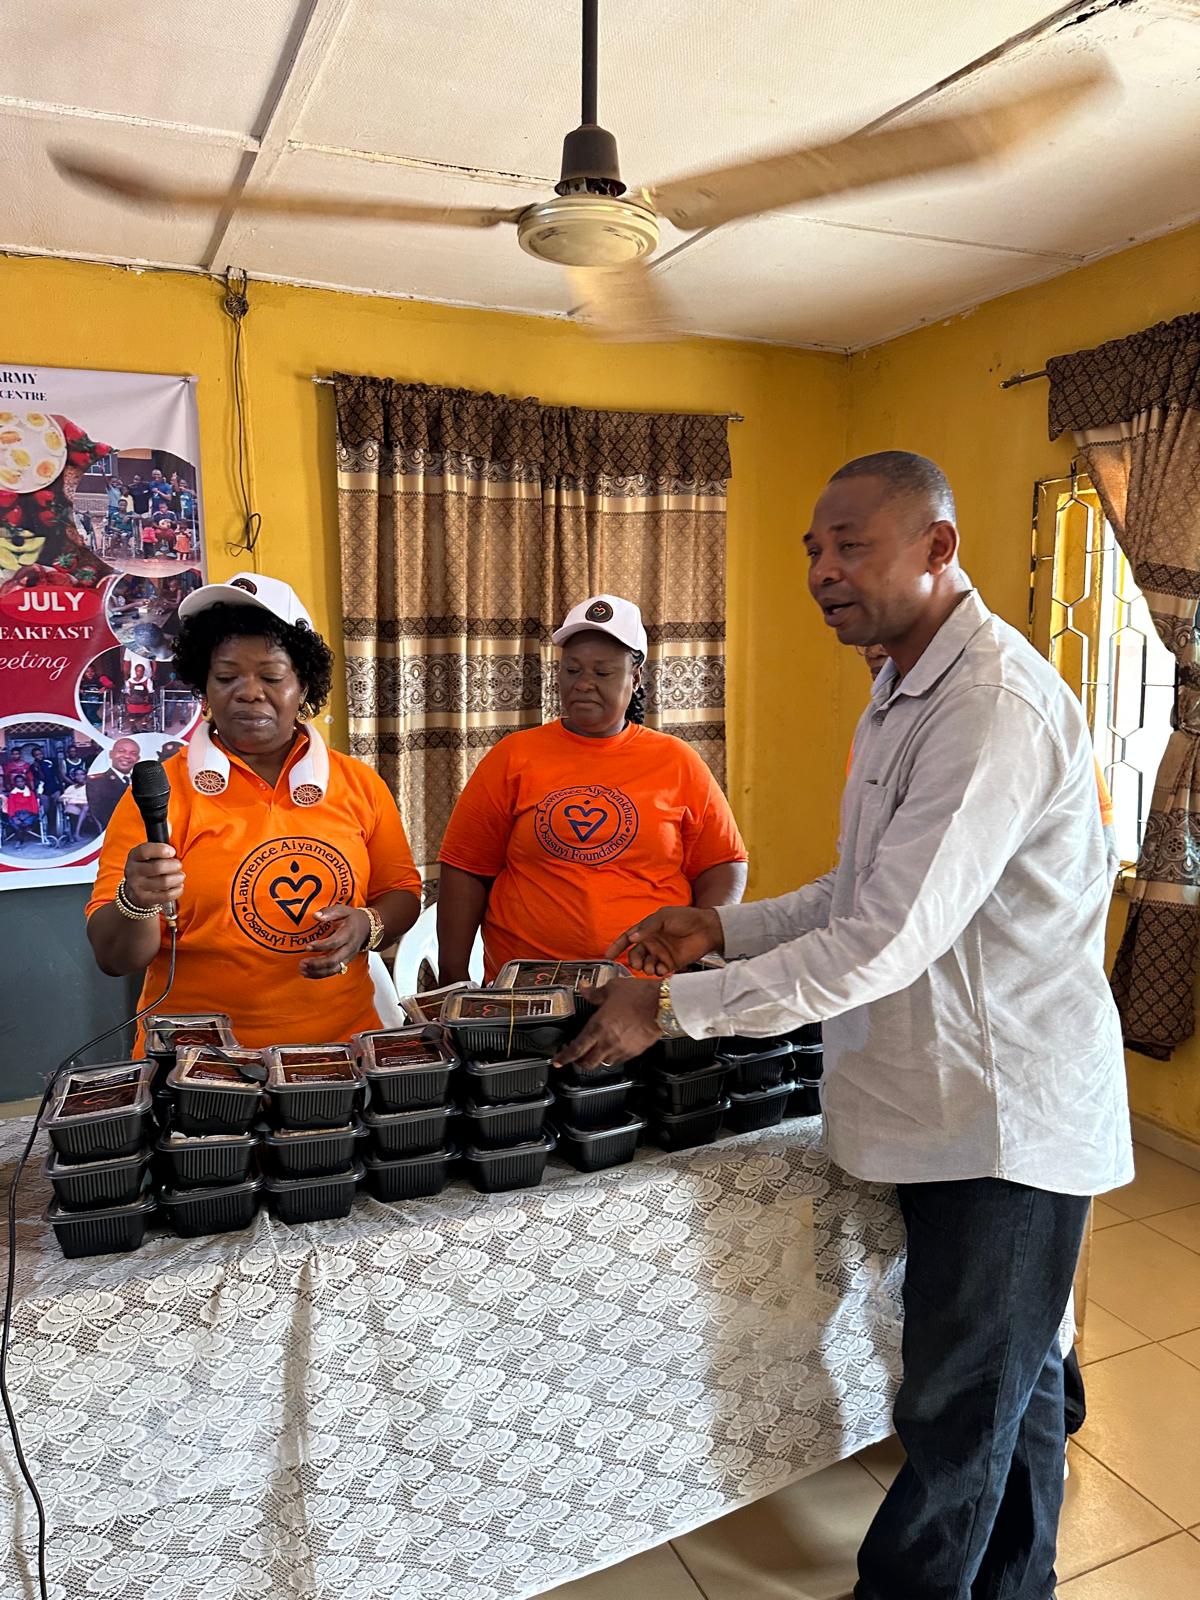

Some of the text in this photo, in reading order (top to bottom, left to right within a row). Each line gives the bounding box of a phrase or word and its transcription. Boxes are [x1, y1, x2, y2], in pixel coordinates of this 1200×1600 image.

[0, 371, 37, 384] RMY
[18, 591, 85, 612] JULY
[0, 626, 93, 640] EAKFAST
[584, 786, 633, 826] Aiyenkhue
[539, 823, 629, 861] Osasuyi Foundation
[236, 840, 349, 906] Lawrence Aiyamenkhue
[243, 911, 333, 947] Osasuyi Founda
